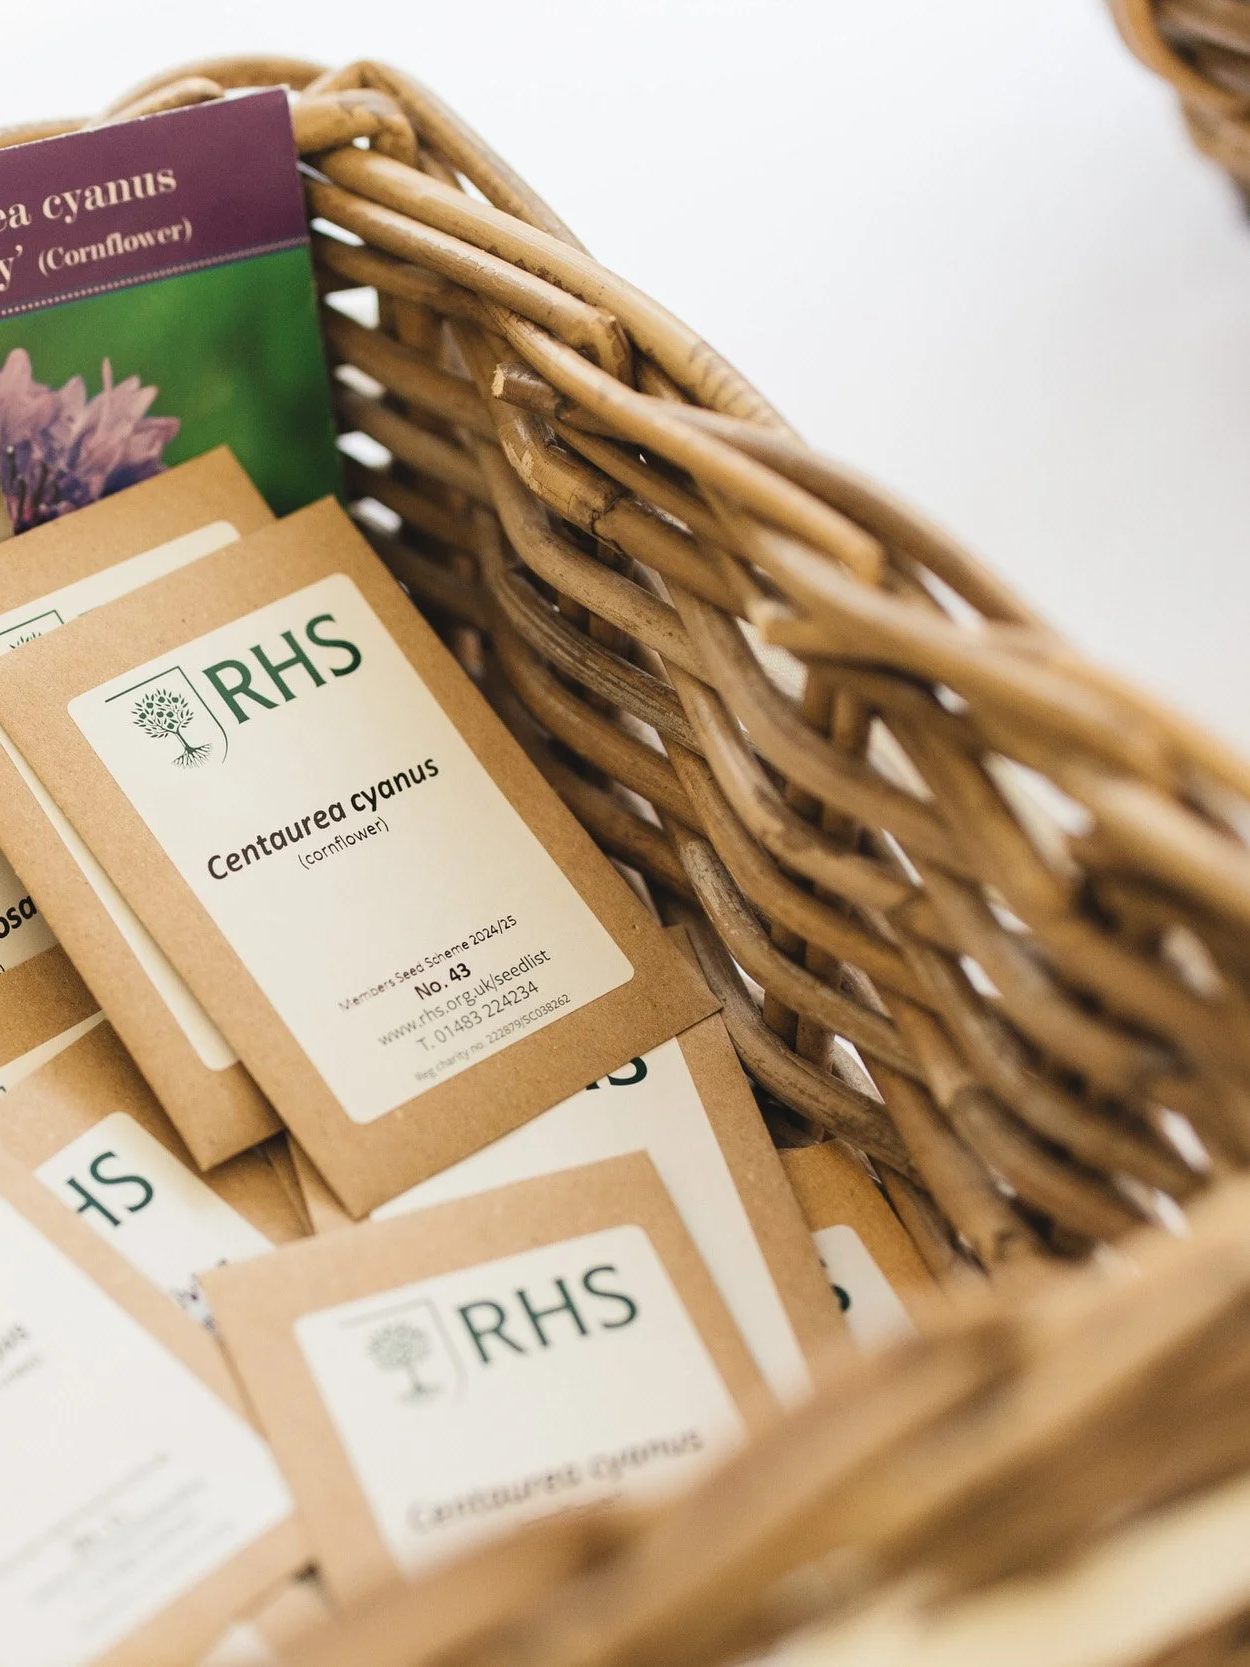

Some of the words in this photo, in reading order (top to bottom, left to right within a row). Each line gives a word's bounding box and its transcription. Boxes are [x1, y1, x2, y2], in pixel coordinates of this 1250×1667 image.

[42, 169, 177, 224] cyanus
[37, 217, 193, 276] (Cornflower)
[201, 613, 363, 724] RHS
[208, 801, 347, 880] Centaurea
[350, 758, 440, 812] cyanus
[297, 816, 390, 870] (cornflower)
[338, 978, 396, 1012] Members
[394, 960, 425, 984] Seed
[424, 939, 470, 969] Scheme
[468, 915, 517, 946] 2024/25
[377, 949, 552, 1048] www.rhs.org.uk/seedlist
[414, 979, 449, 1000] No.
[449, 962, 472, 983] 43
[416, 1036, 436, 1052] T.
[434, 1009, 483, 1045] 01483
[481, 980, 539, 1018] 224234
[436, 1045, 471, 1072] charity
[469, 1040, 485, 1056] no.
[485, 993, 572, 1044] 222879/SC038262
[458, 1263, 639, 1365] RHS
[405, 1460, 582, 1535] Centaurea
[588, 1428, 705, 1484] cyanus
